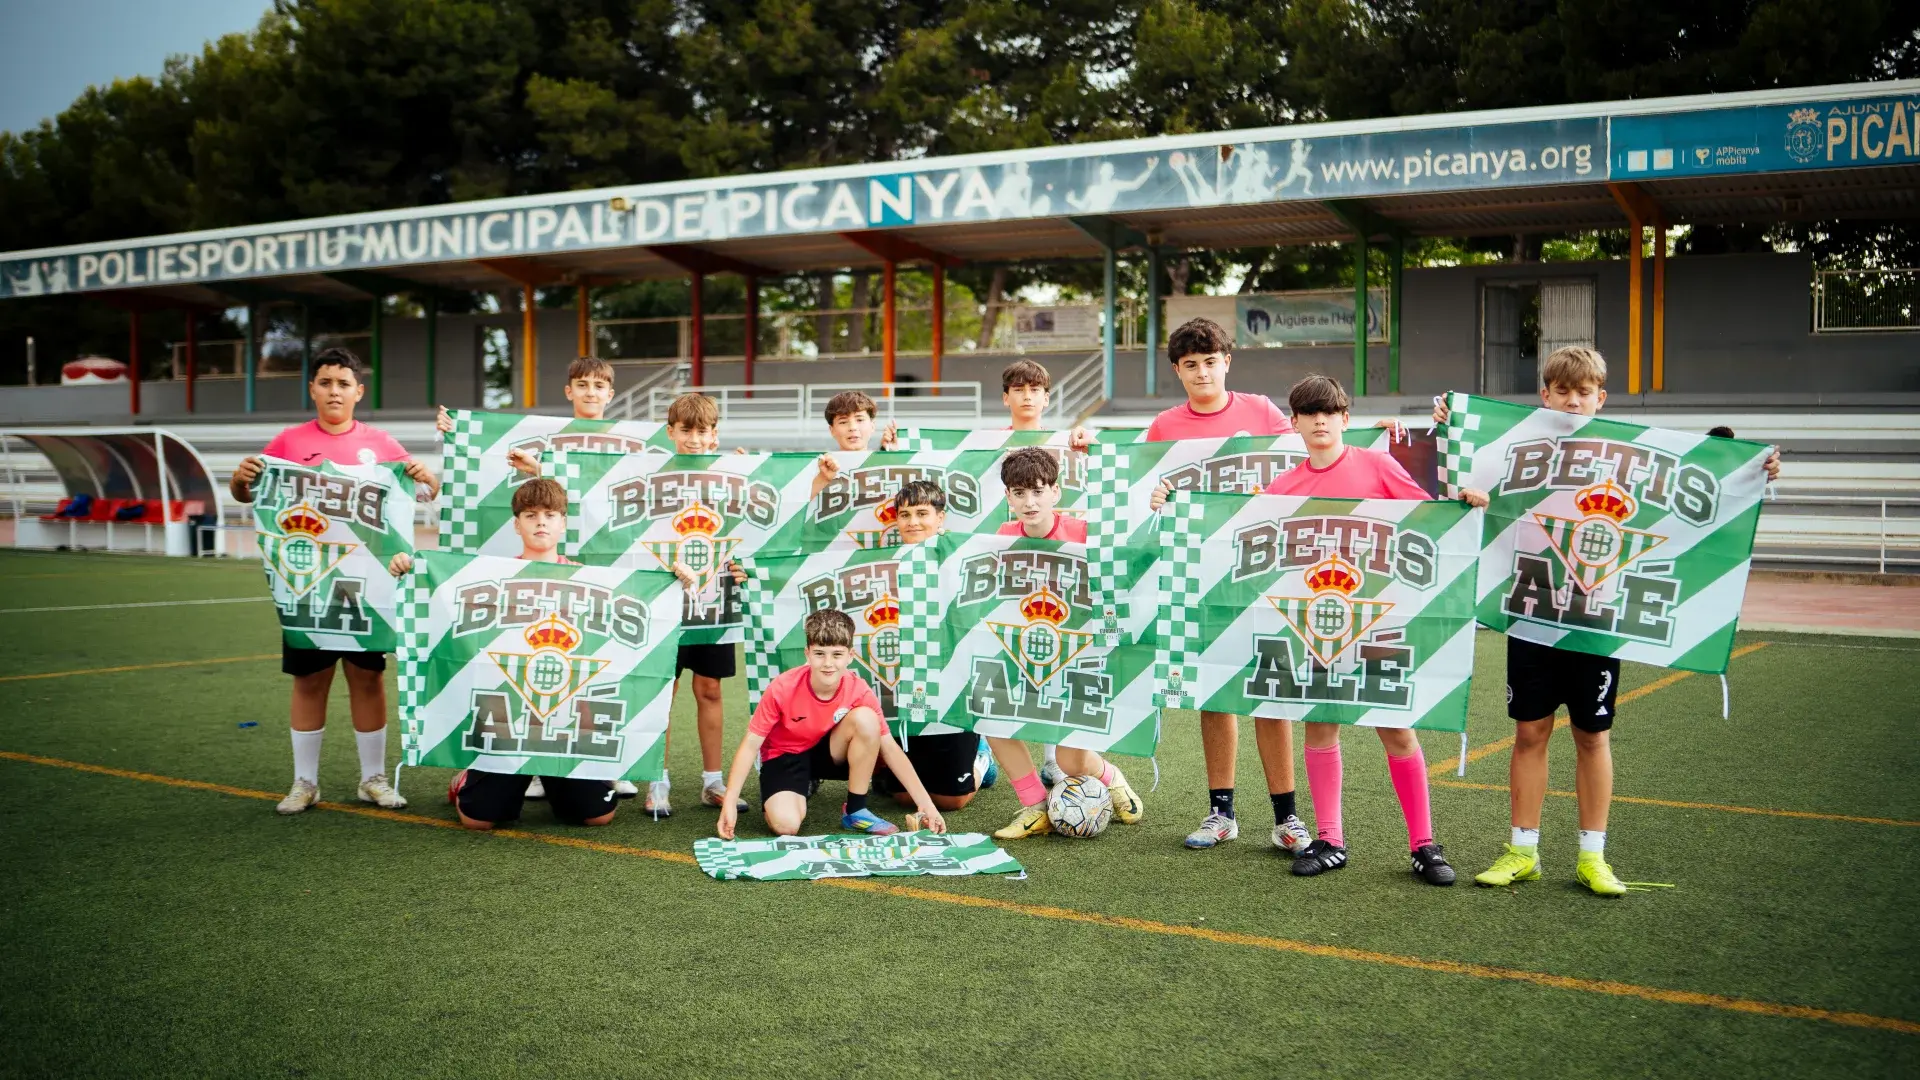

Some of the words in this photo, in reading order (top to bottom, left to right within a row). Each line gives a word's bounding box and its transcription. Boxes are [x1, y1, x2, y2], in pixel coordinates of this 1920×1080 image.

[1321, 143, 1592, 184] www.picanya.org
[77, 229, 346, 288] POLIESPORTIU
[361, 203, 611, 263] MUNICIPAL
[635, 196, 705, 241] DE
[732, 171, 999, 233] PICANYA
[1318, 314, 1329, 325] de
[608, 469, 781, 531] BETIS
[1499, 436, 1721, 527] BETIS
[798, 559, 900, 620] BET
[957, 549, 1092, 610] BETI
[1231, 515, 1439, 591] BETIS
[452, 578, 651, 650] BETIS
[1500, 551, 1681, 648] ALÉ
[966, 655, 1114, 735] ALÉ
[1243, 626, 1415, 711] ALÉ
[462, 682, 627, 763] ALÉ
